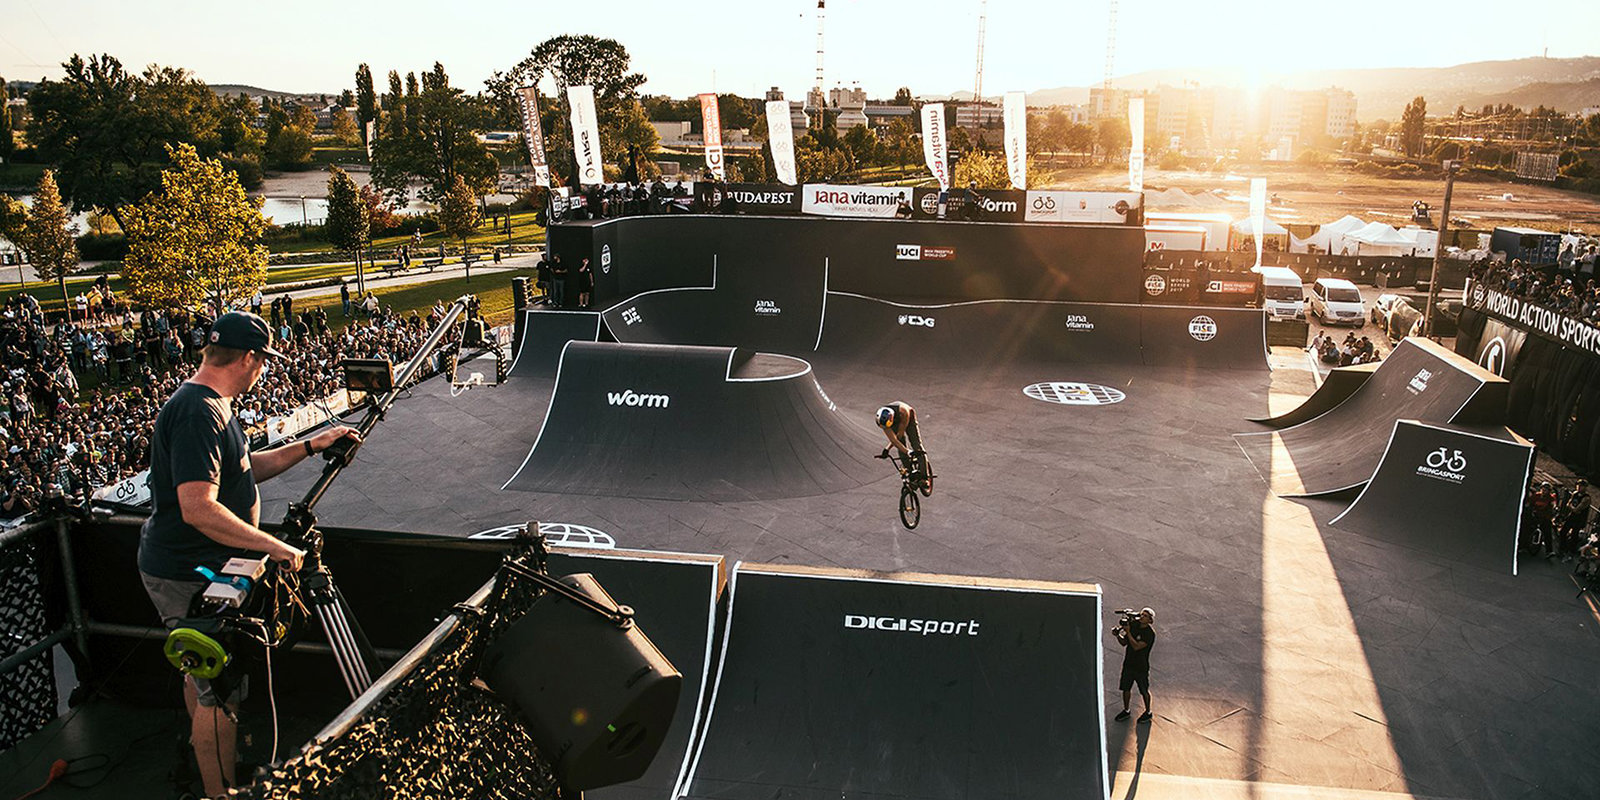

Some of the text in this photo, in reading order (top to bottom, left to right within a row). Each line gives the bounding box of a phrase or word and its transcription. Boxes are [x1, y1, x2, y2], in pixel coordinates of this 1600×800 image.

[901, 248, 918, 256] UCI
[1487, 289, 1519, 320] WORLD
[1519, 302, 1560, 337] ACTION
[607, 389, 670, 408] Worm
[1417, 465, 1466, 481] BRINGASPORT
